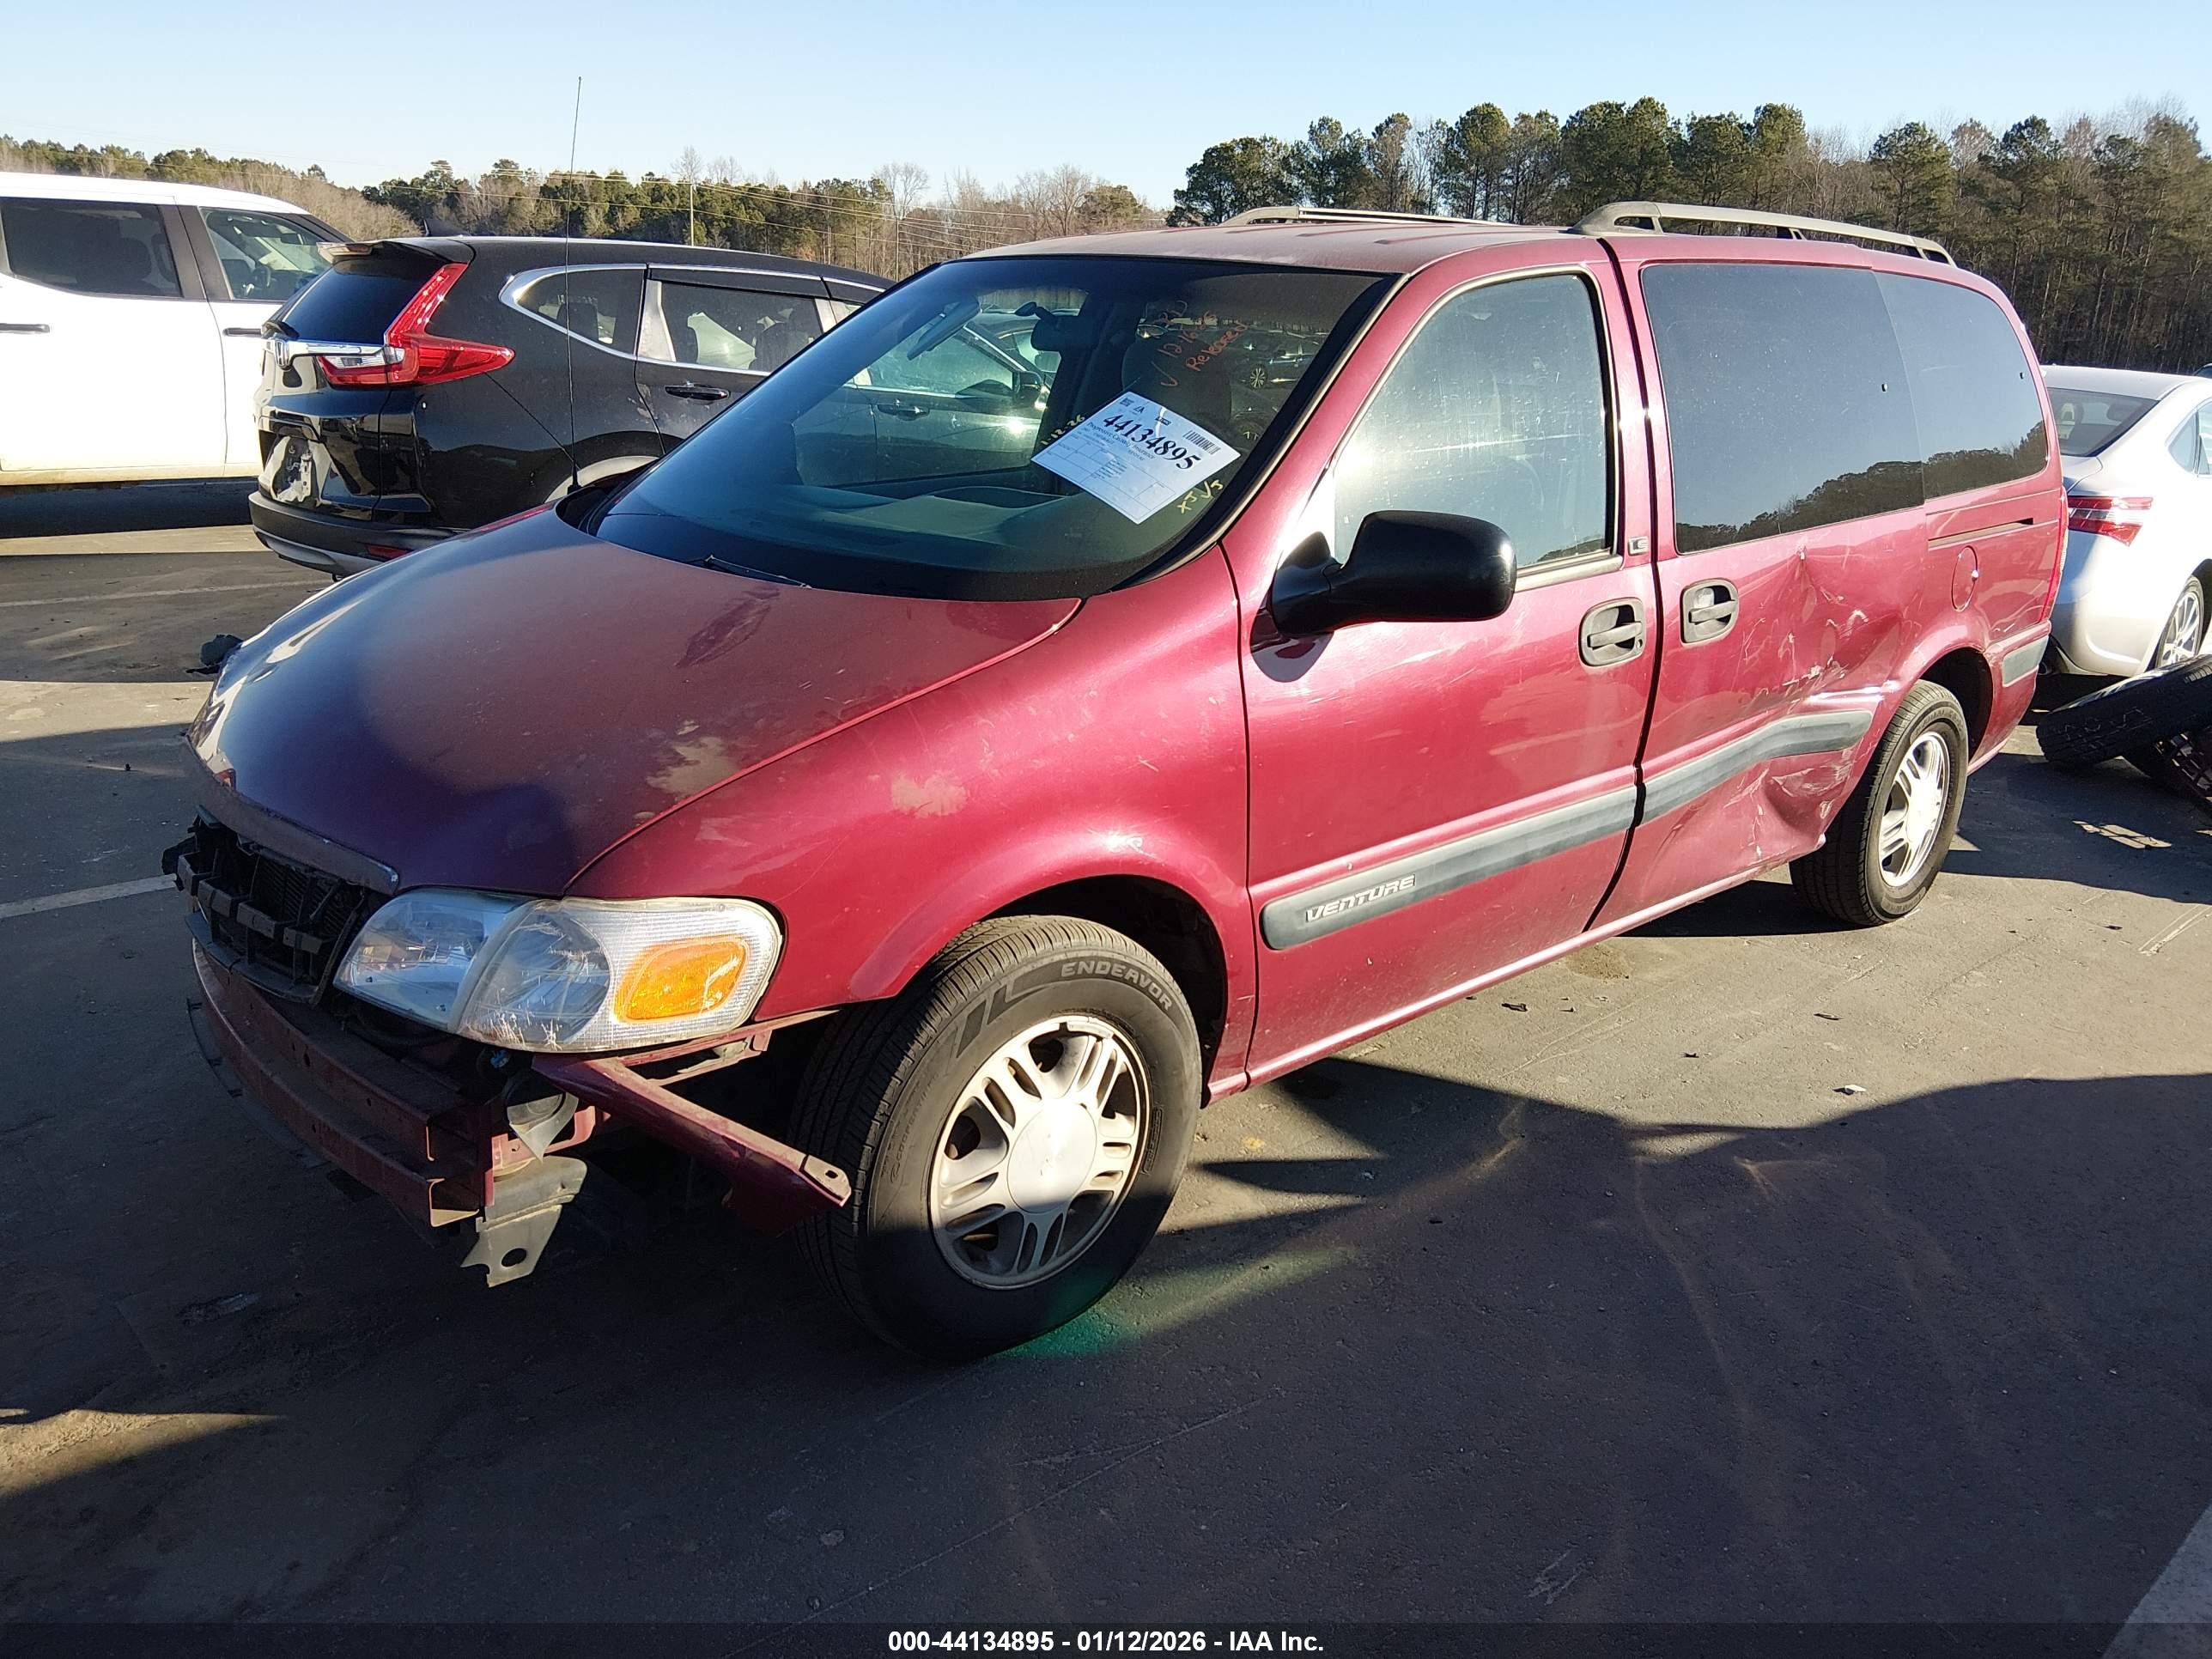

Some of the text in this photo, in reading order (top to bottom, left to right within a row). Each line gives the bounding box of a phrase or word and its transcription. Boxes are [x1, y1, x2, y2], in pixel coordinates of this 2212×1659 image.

[1103, 415, 1201, 470] 44134895
[1306, 874, 1415, 922] VENTURE
[1060, 960, 1173, 1011] ENDEAVOR
